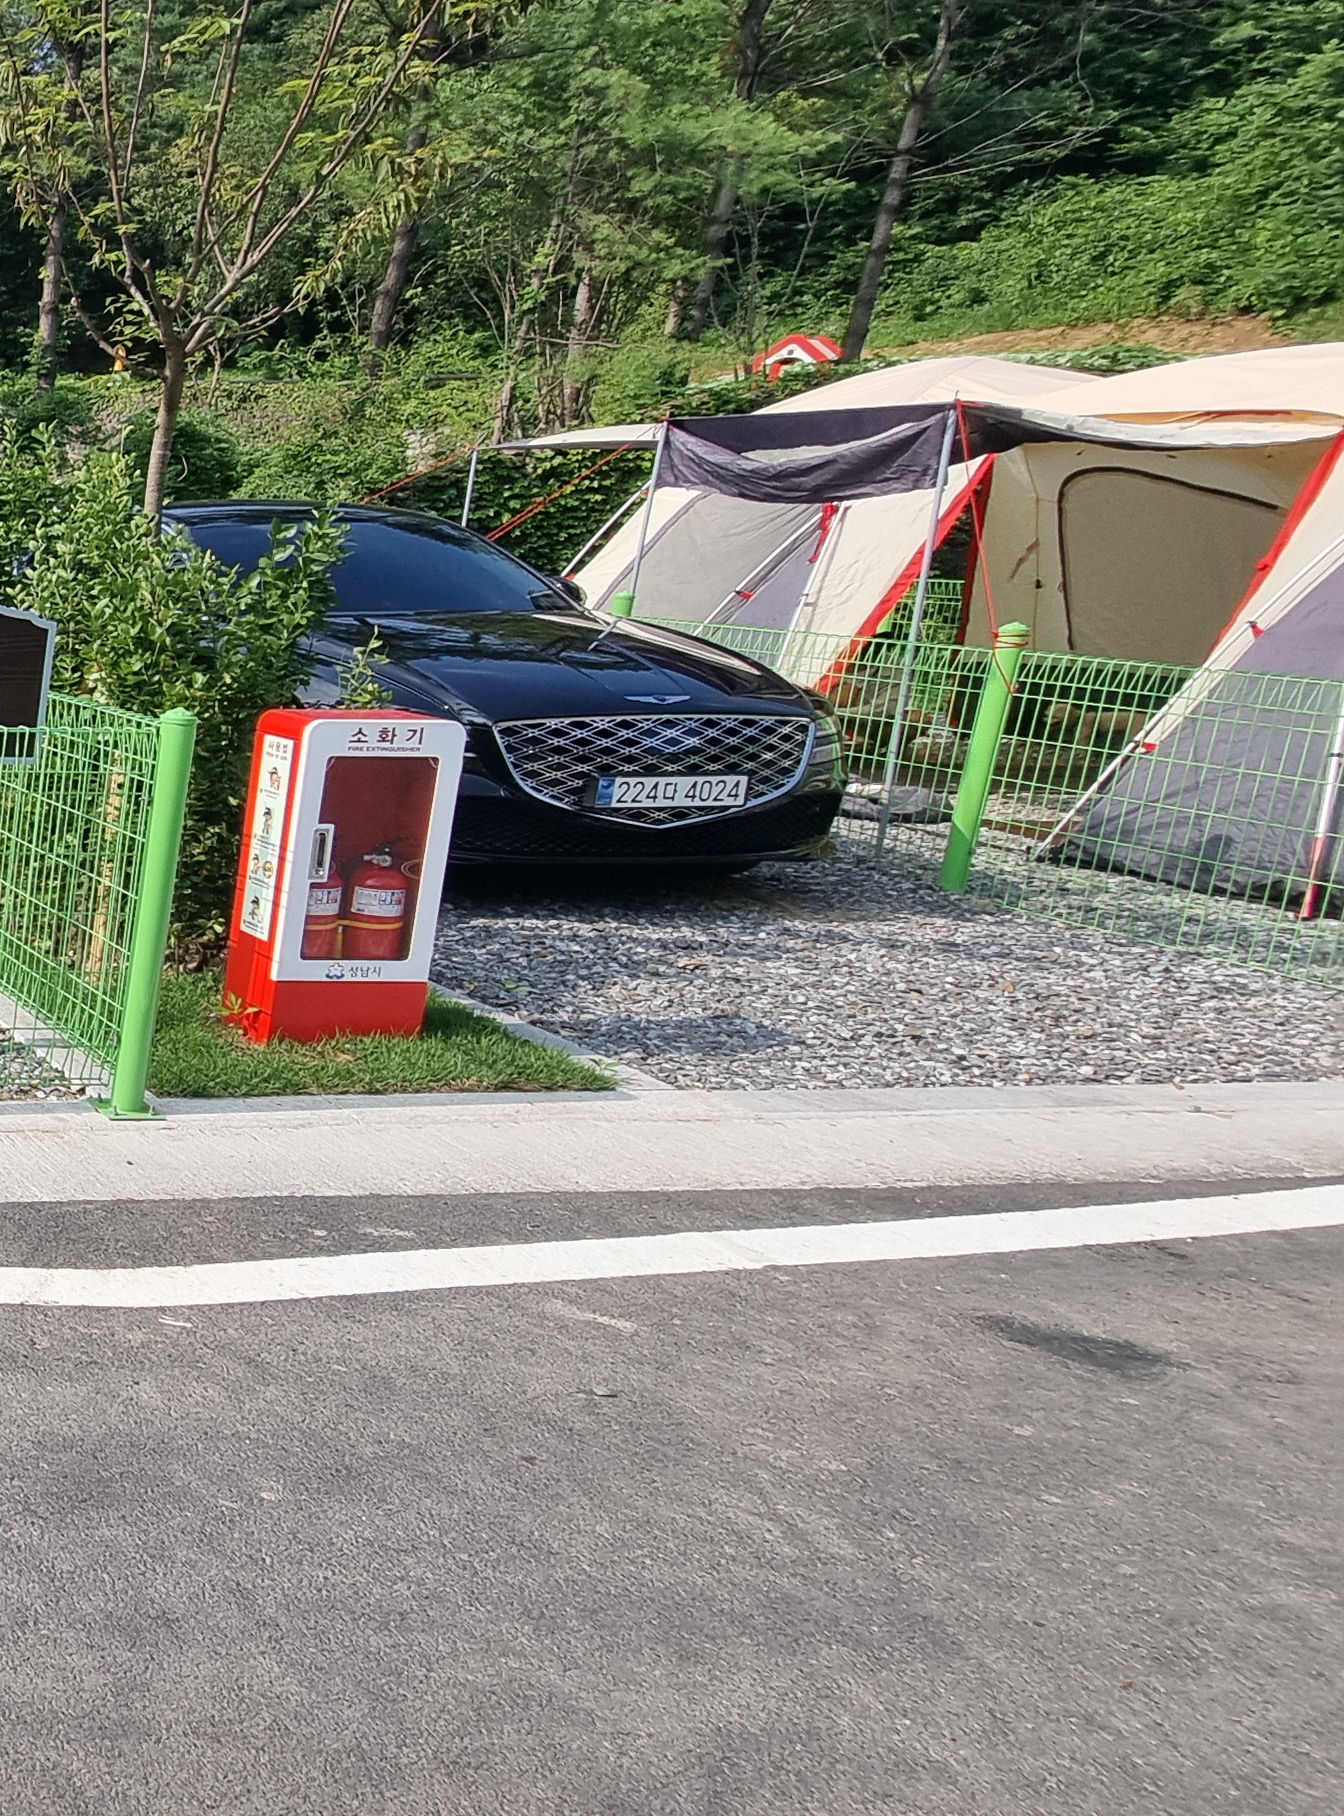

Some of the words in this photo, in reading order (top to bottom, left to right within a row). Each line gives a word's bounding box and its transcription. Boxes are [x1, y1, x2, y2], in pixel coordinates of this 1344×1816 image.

[616, 781, 678, 804] 224다
[684, 780, 741, 802] 4024
[348, 966, 382, 978] 성남시
